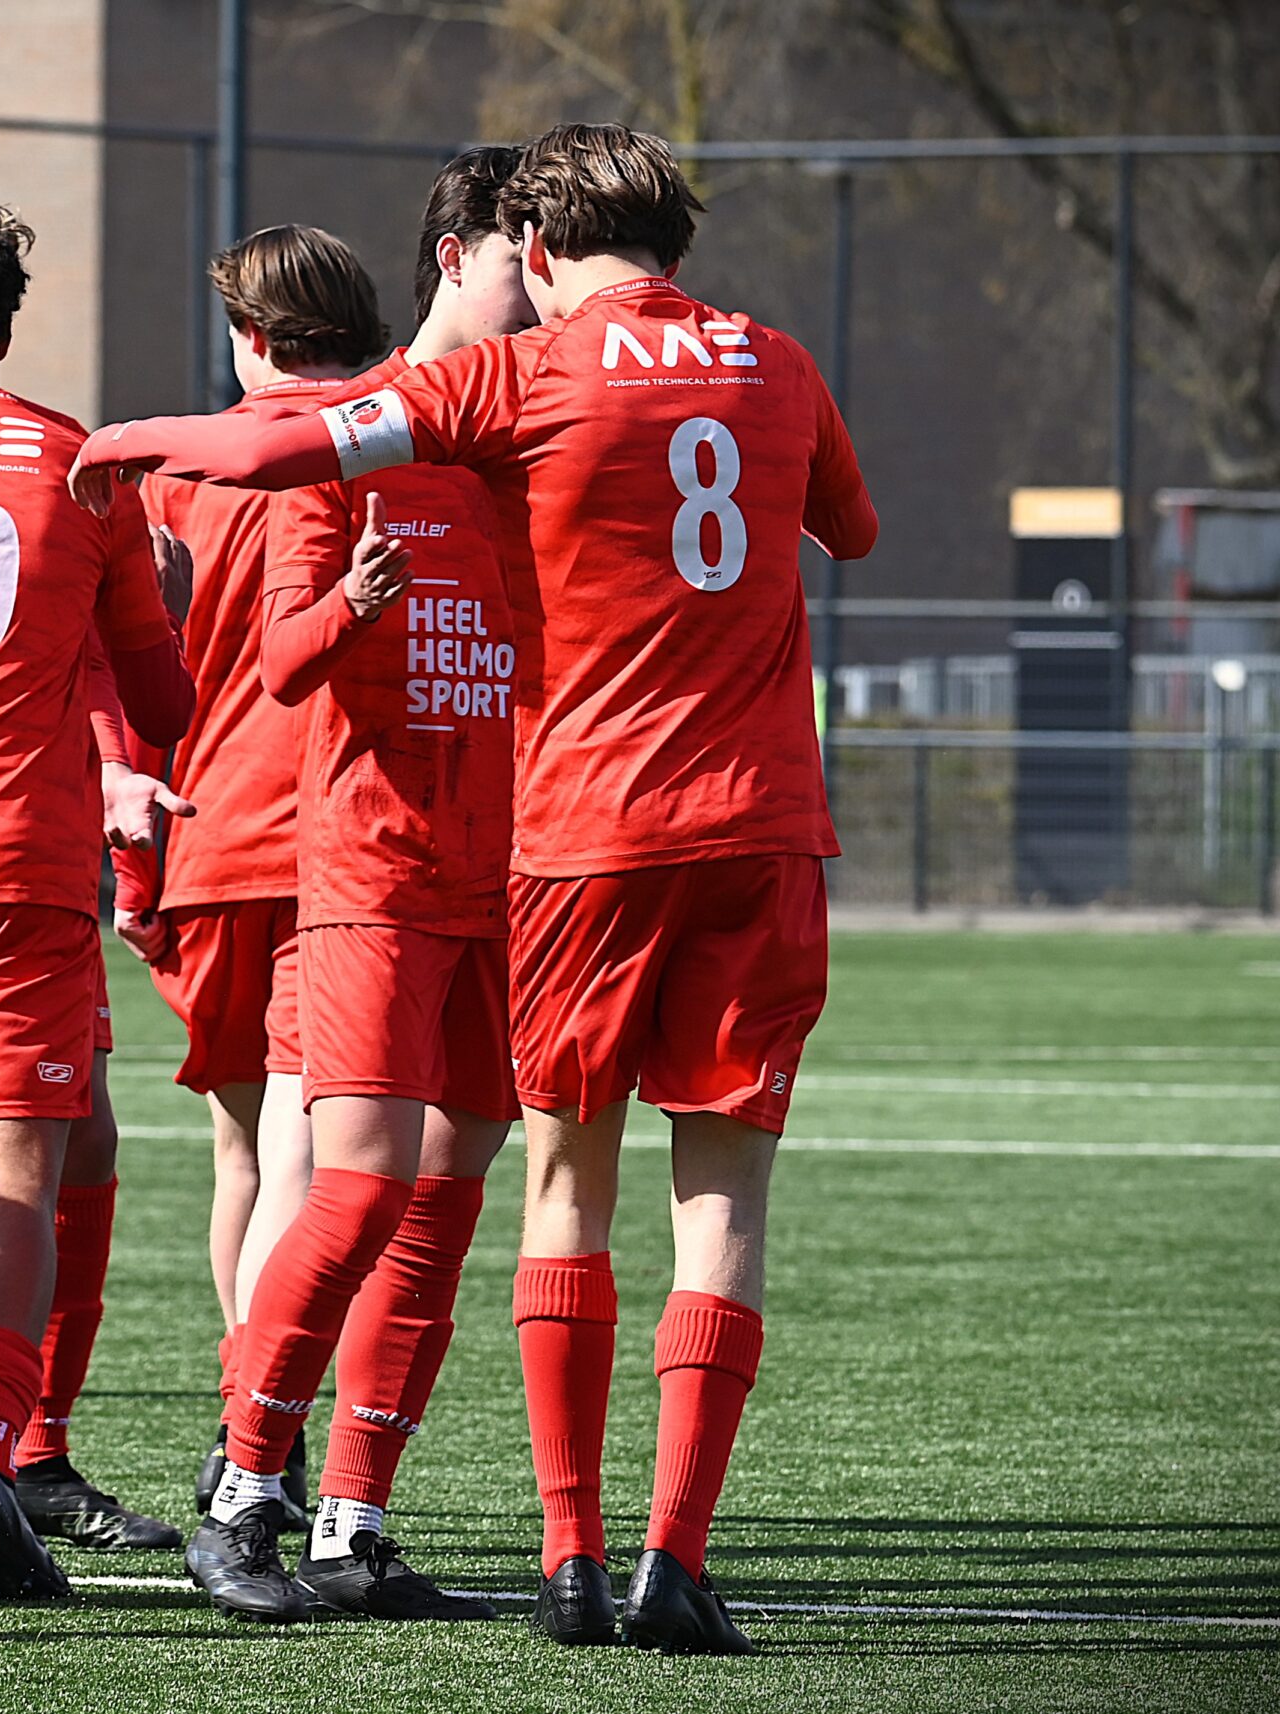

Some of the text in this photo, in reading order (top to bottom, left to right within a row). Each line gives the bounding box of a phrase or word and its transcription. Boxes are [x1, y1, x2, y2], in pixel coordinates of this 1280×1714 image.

[616, 281, 651, 293] WELLEKE
[607, 377, 765, 388] PUSHING TECHNICAL BOUNDARIES
[344, 424, 361, 452] SPORT
[668, 416, 748, 592] 8
[407, 597, 488, 636] HEEL
[407, 638, 516, 679] HELMO
[406, 679, 511, 718] SPORT
